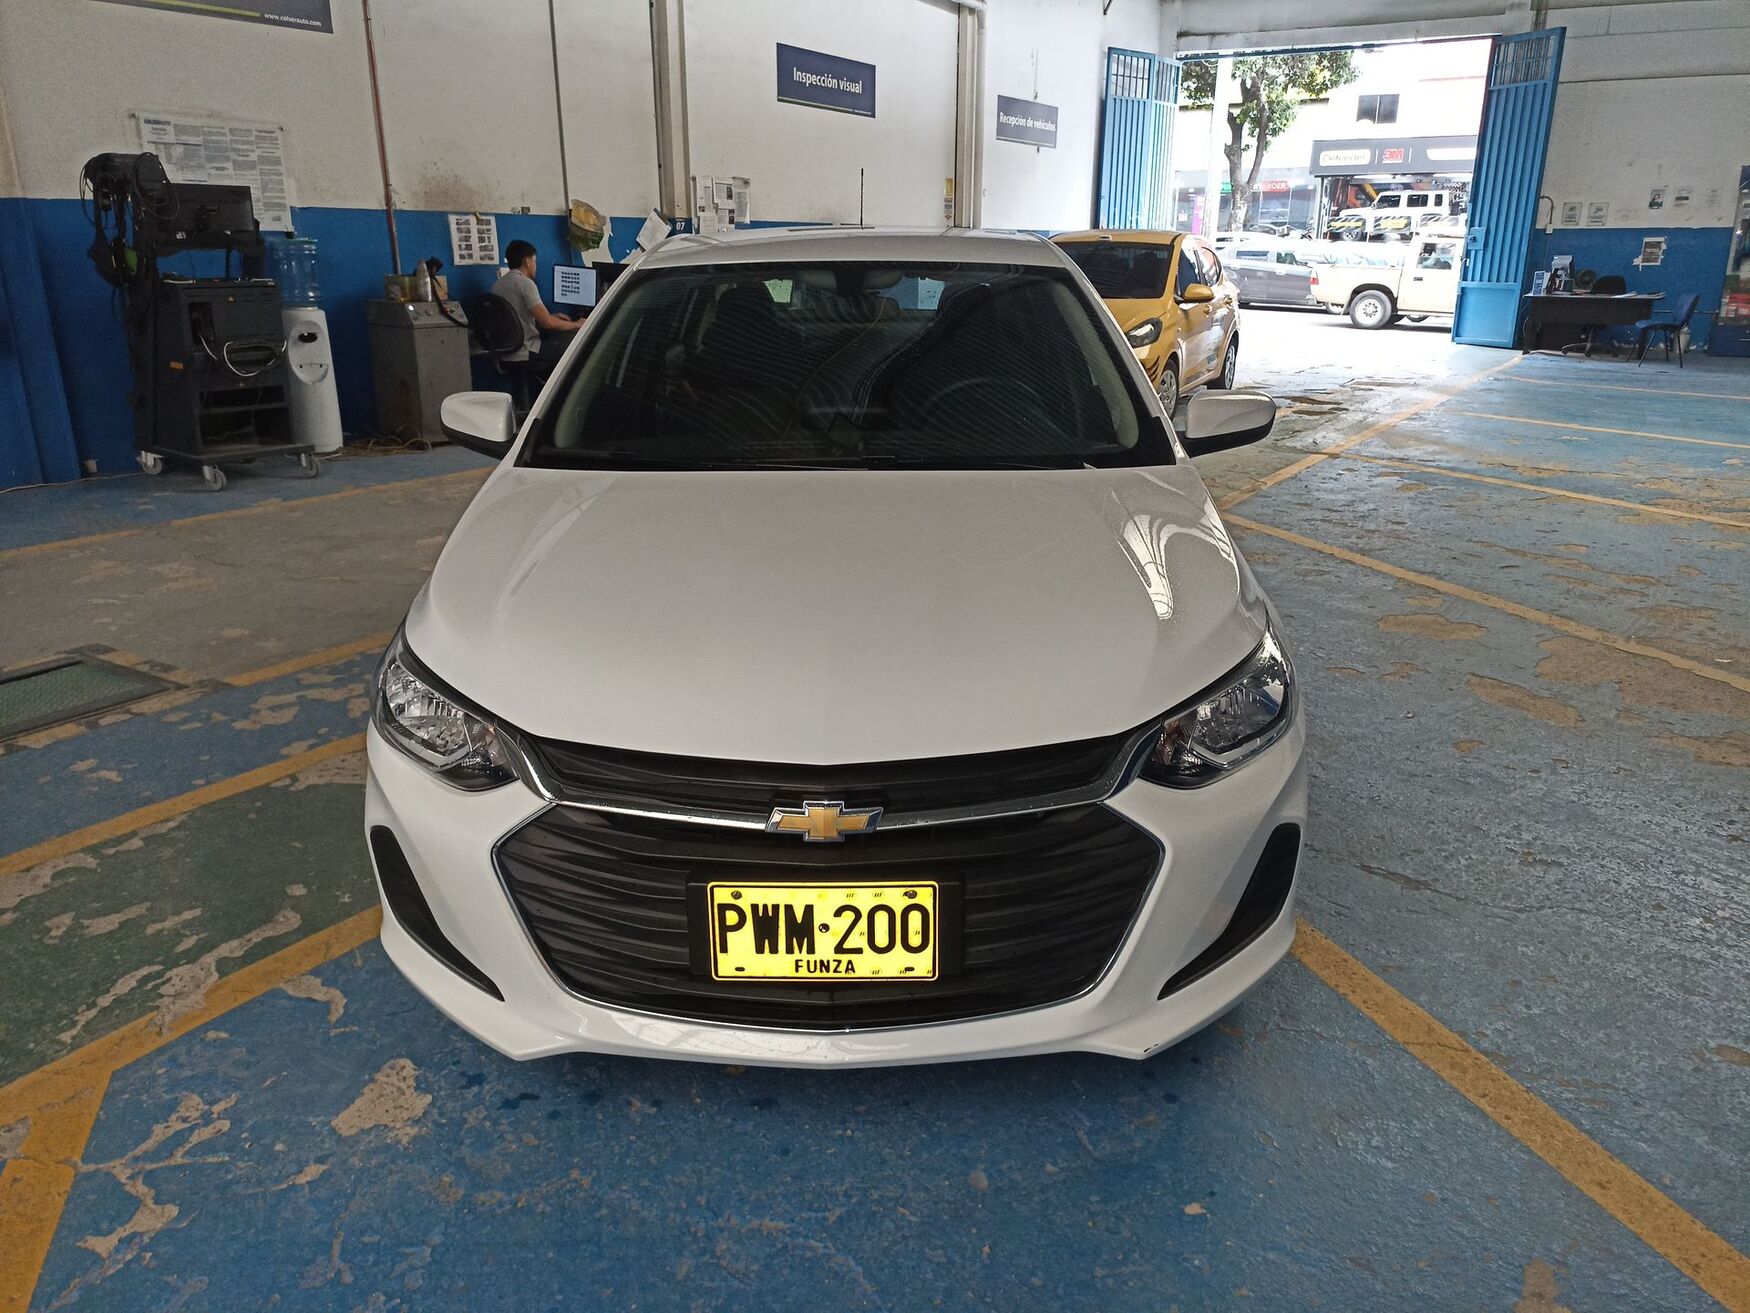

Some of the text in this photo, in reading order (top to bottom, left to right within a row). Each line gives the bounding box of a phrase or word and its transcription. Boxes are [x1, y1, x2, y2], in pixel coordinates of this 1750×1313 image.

[793, 66, 862, 94] Inspección visual
[999, 111, 1026, 127] Recepción
[1026, 117, 1034, 128] de
[1382, 149, 1405, 161] 3M
[676, 221, 685, 231] 07
[794, 959, 857, 975] FUNZA
